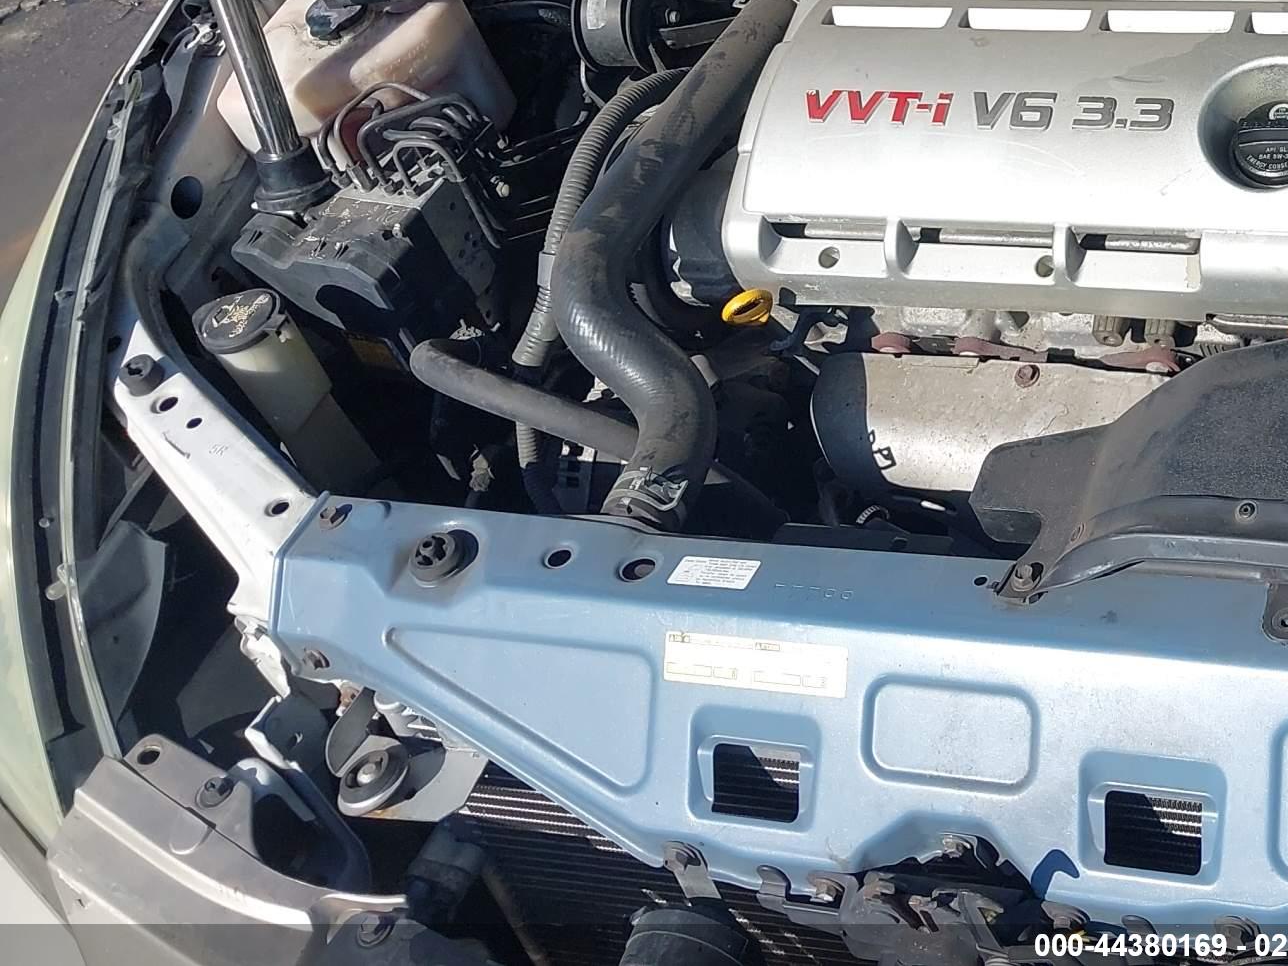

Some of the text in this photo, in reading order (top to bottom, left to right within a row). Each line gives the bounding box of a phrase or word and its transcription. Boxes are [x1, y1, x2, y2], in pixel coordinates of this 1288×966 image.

[805, 90, 1175, 132] VVT-i V6 3.3
[1246, 154, 1268, 169] ENERGY
